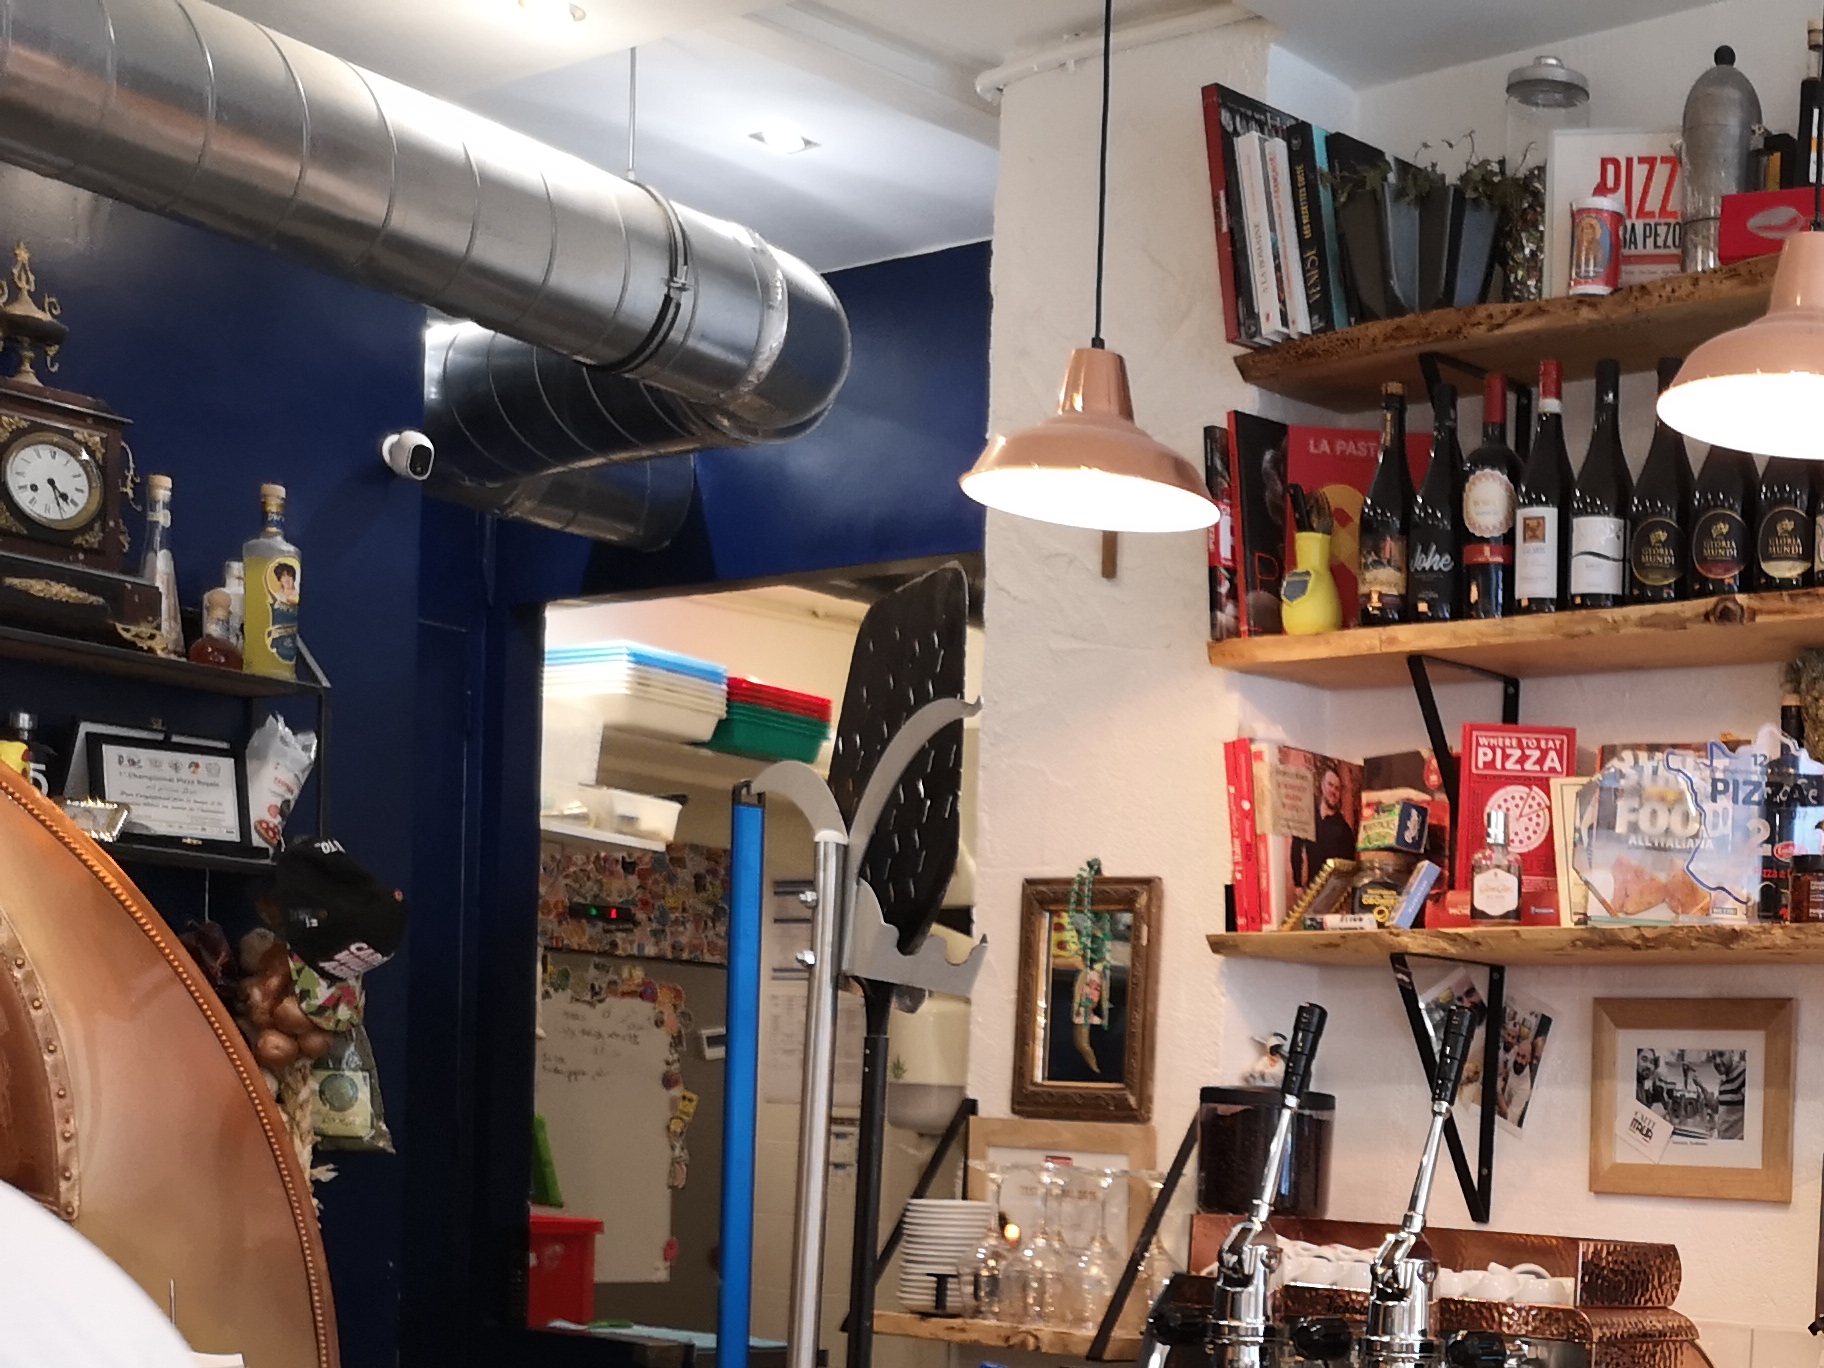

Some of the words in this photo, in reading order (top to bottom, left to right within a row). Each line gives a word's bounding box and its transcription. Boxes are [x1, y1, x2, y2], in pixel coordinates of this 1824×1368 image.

[1308, 438, 1331, 455] LA
[1478, 736, 1517, 749] WHERE
[1521, 736, 1537, 749] TO
[1540, 738, 1562, 750] EAT
[1476, 747, 1563, 773] PIZZA
